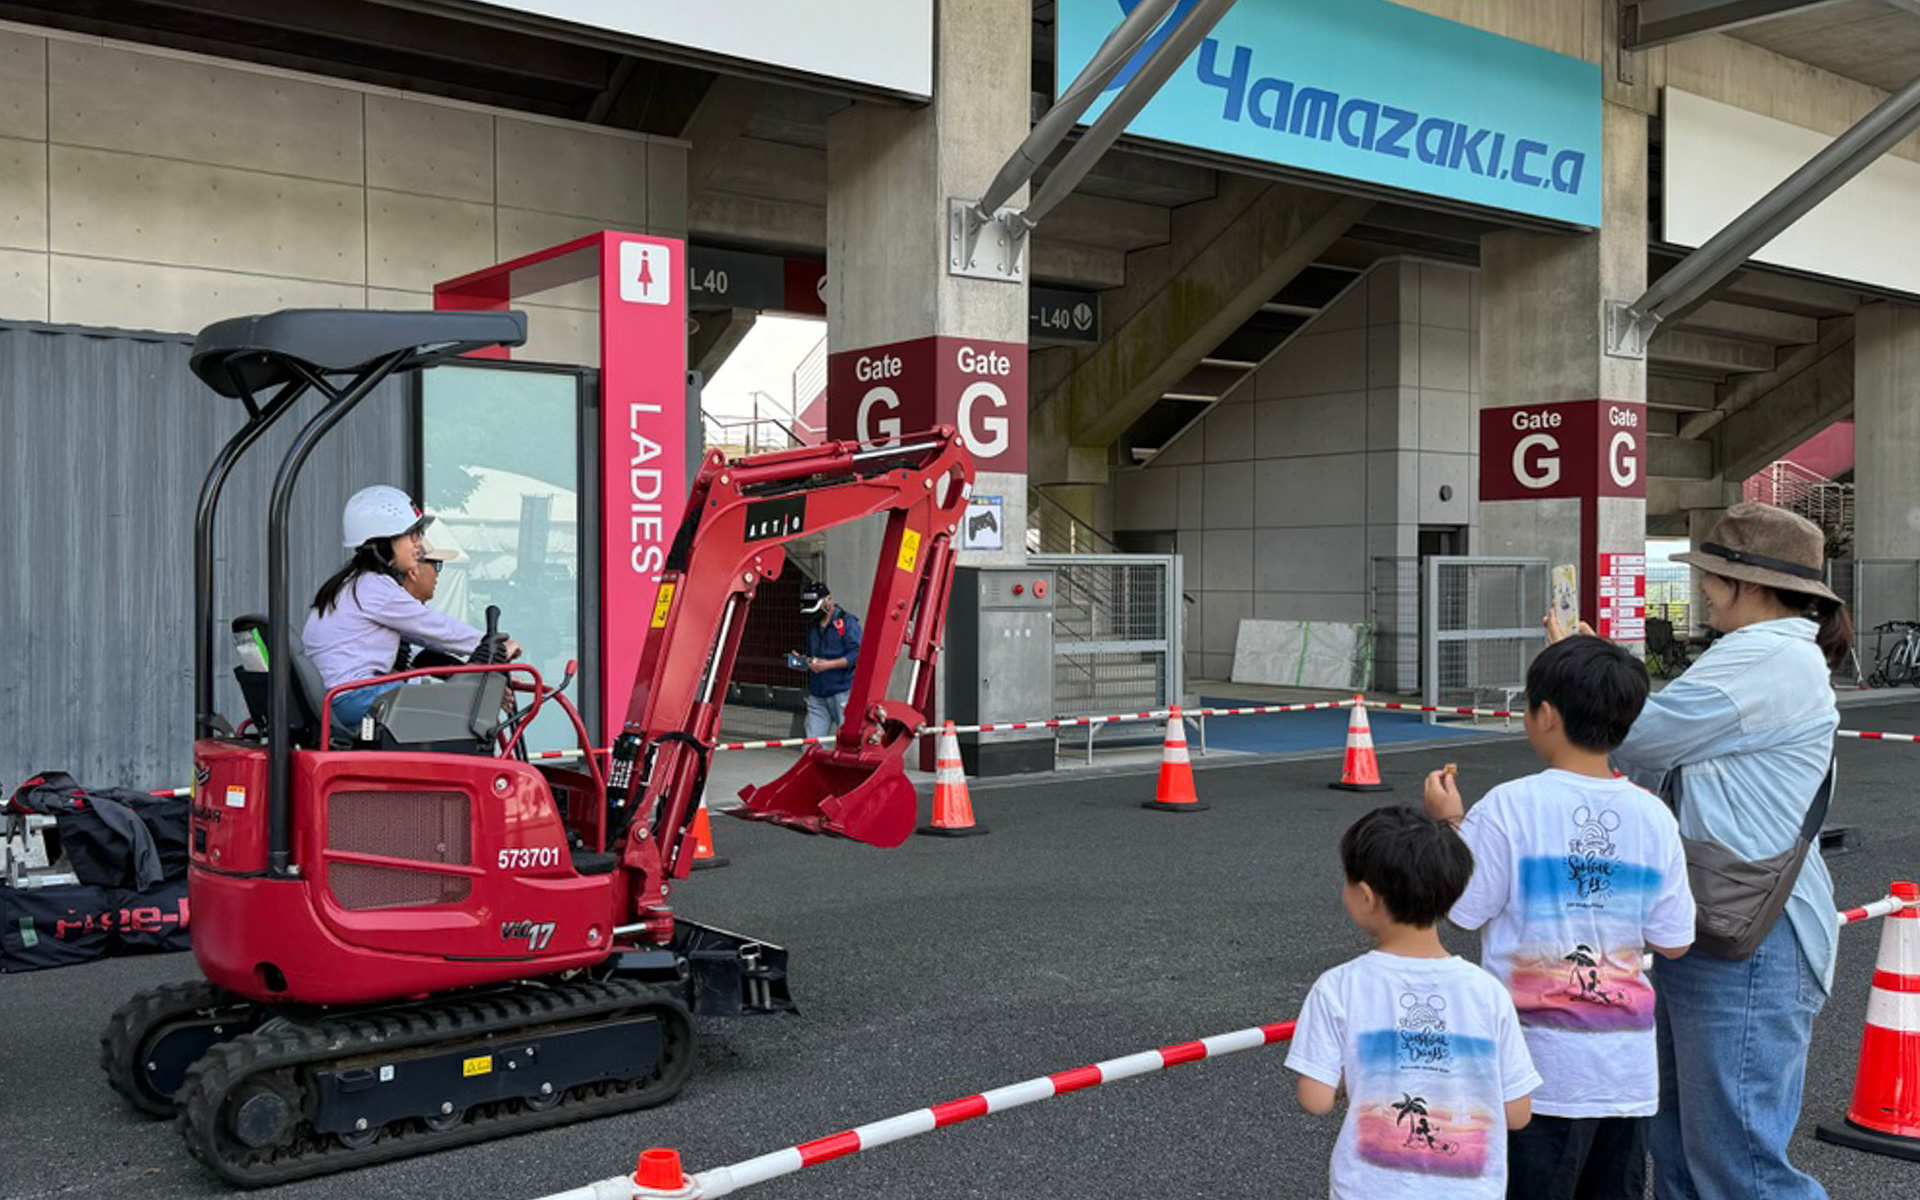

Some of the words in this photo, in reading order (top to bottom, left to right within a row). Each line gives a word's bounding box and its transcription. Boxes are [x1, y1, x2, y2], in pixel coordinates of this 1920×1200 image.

[689, 267, 728, 294] L40
[856, 354, 903, 382] Gate
[956, 346, 1011, 376] Gate
[857, 386, 902, 453] G
[957, 381, 1009, 458] G
[1512, 409, 1562, 431] Gate
[1609, 405, 1638, 427] Gate
[1512, 432, 1561, 489] G
[1609, 431, 1637, 488] G
[497, 847, 559, 869] 573701
